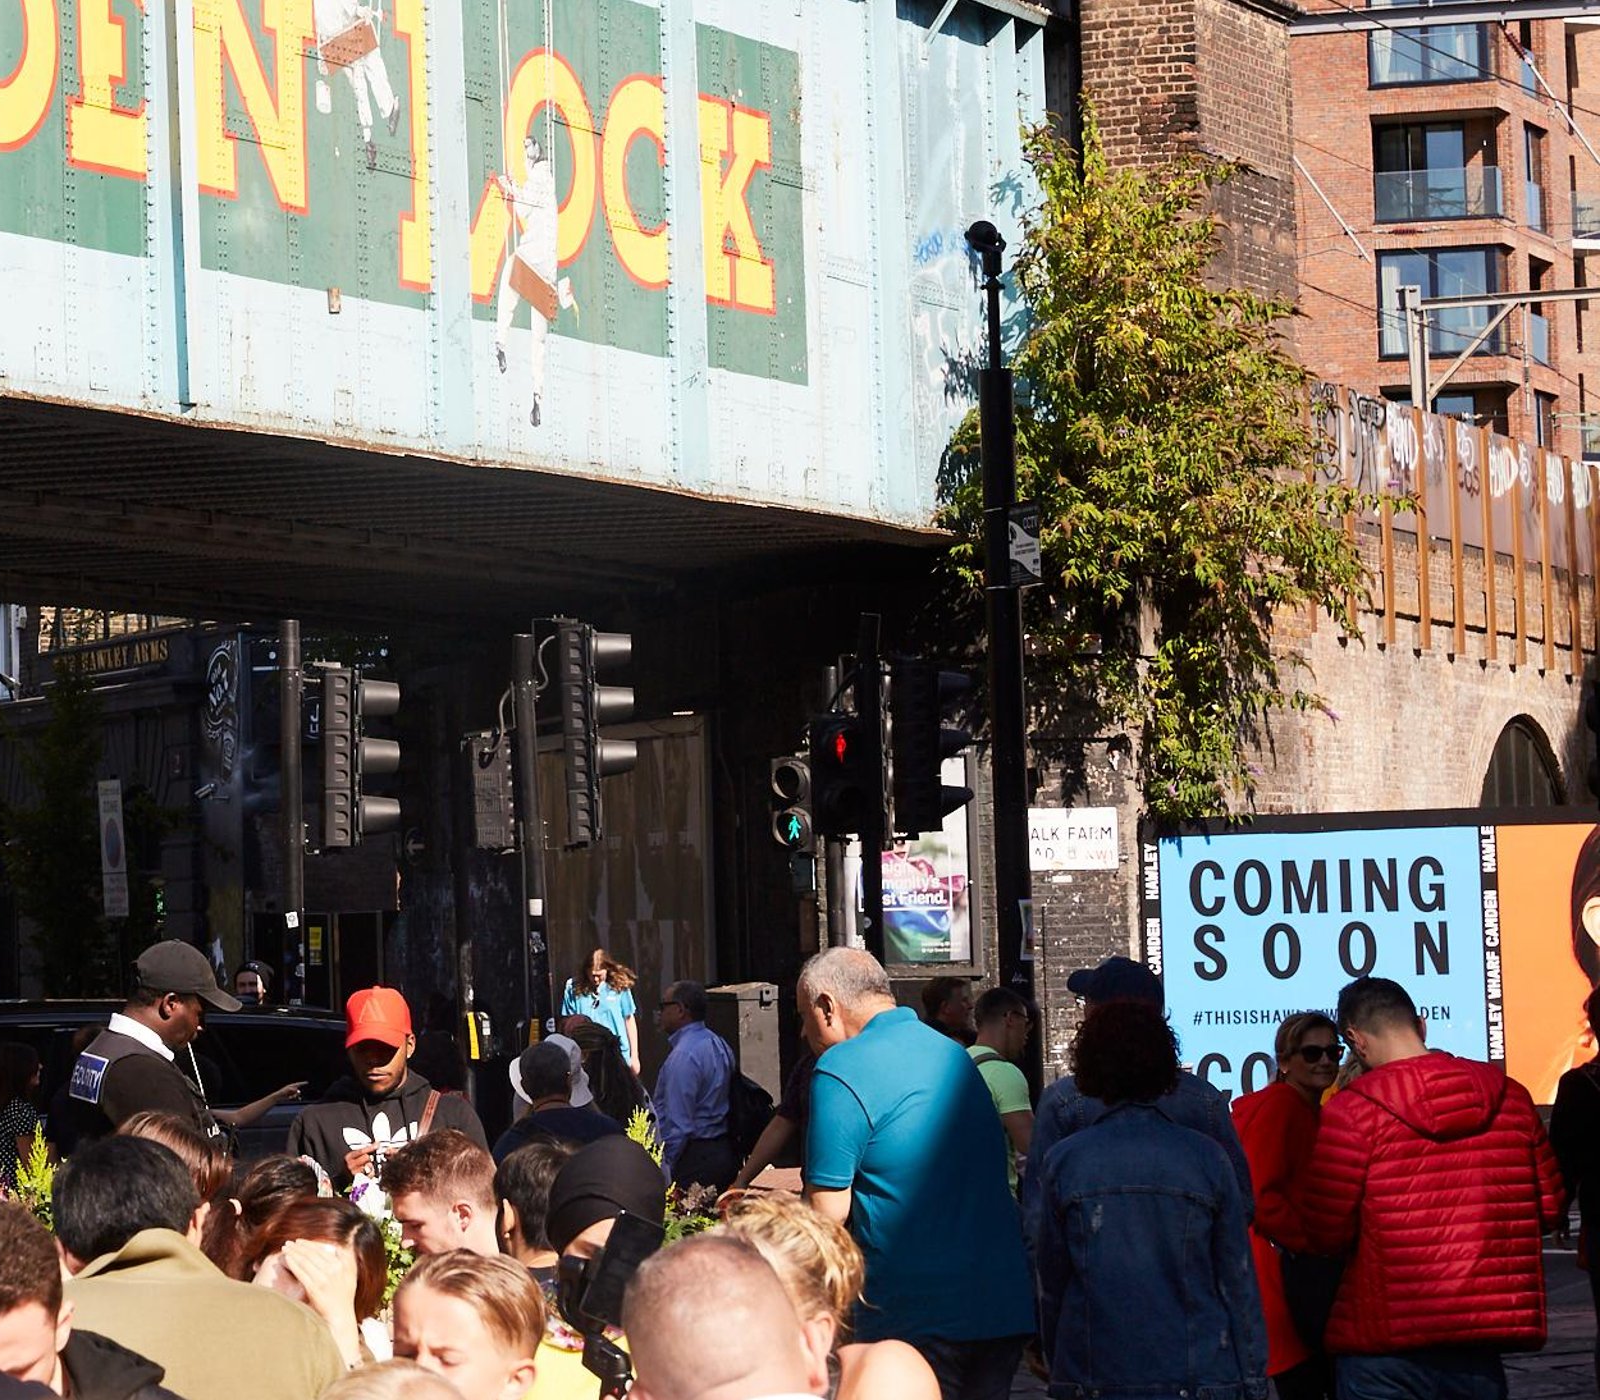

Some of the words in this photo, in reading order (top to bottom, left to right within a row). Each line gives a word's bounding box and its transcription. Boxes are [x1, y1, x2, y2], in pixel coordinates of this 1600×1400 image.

[392, 0, 777, 316] LOCK
[133, 638, 169, 665] ARMS
[1031, 826, 1060, 841] ALK
[1480, 825, 1496, 873] HAWLE
[900, 890, 948, 905] Friend.
[1144, 843, 1159, 899] HAWLEY
[1189, 856, 1446, 917] COMING
[1484, 890, 1499, 947] CAMDEN
[1146, 918, 1162, 975] CAMDEN
[1193, 921, 1450, 981] SOON
[1486, 951, 1502, 999] WHARF
[1490, 1005, 1505, 1060] HAWLEY
[71, 1062, 102, 1089] ECURITY
